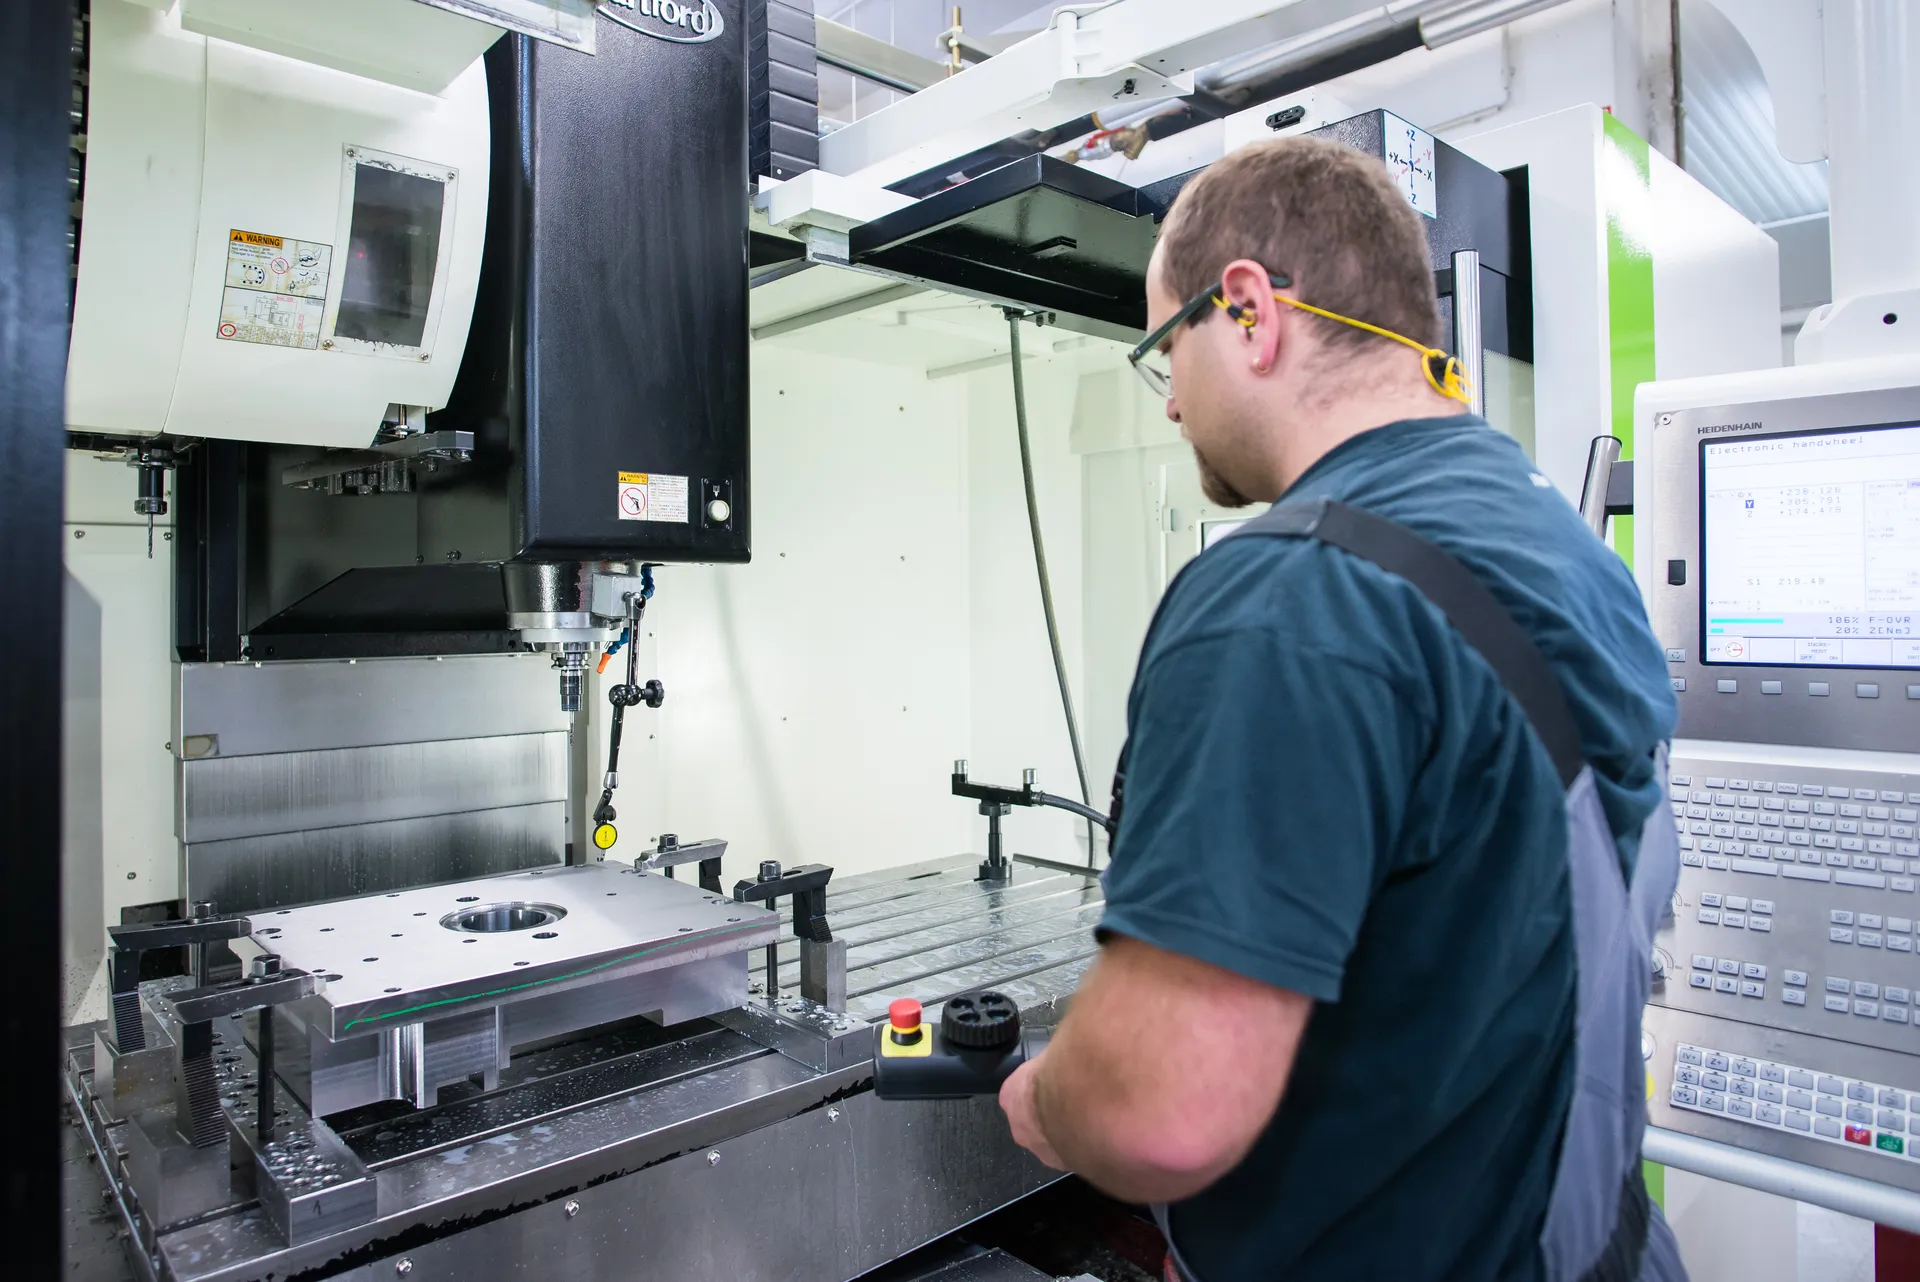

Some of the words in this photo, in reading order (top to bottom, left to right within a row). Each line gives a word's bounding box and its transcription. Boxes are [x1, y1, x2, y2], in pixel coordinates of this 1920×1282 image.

[1406, 129, 1415, 141] +Z
[1389, 152, 1399, 165] +X
[1423, 169, 1432, 182] -X
[1408, 193, 1416, 205] -Z
[246, 234, 280, 246] WARNING
[1697, 421, 1762, 434] HEIDENHAIN
[1710, 443, 1784, 455] Electronic
[1792, 435, 1863, 448] handwheel
[1746, 500, 1754, 508] Y
[1869, 616, 1911, 624] F-OVR
[1835, 626, 1859, 634] 20%
